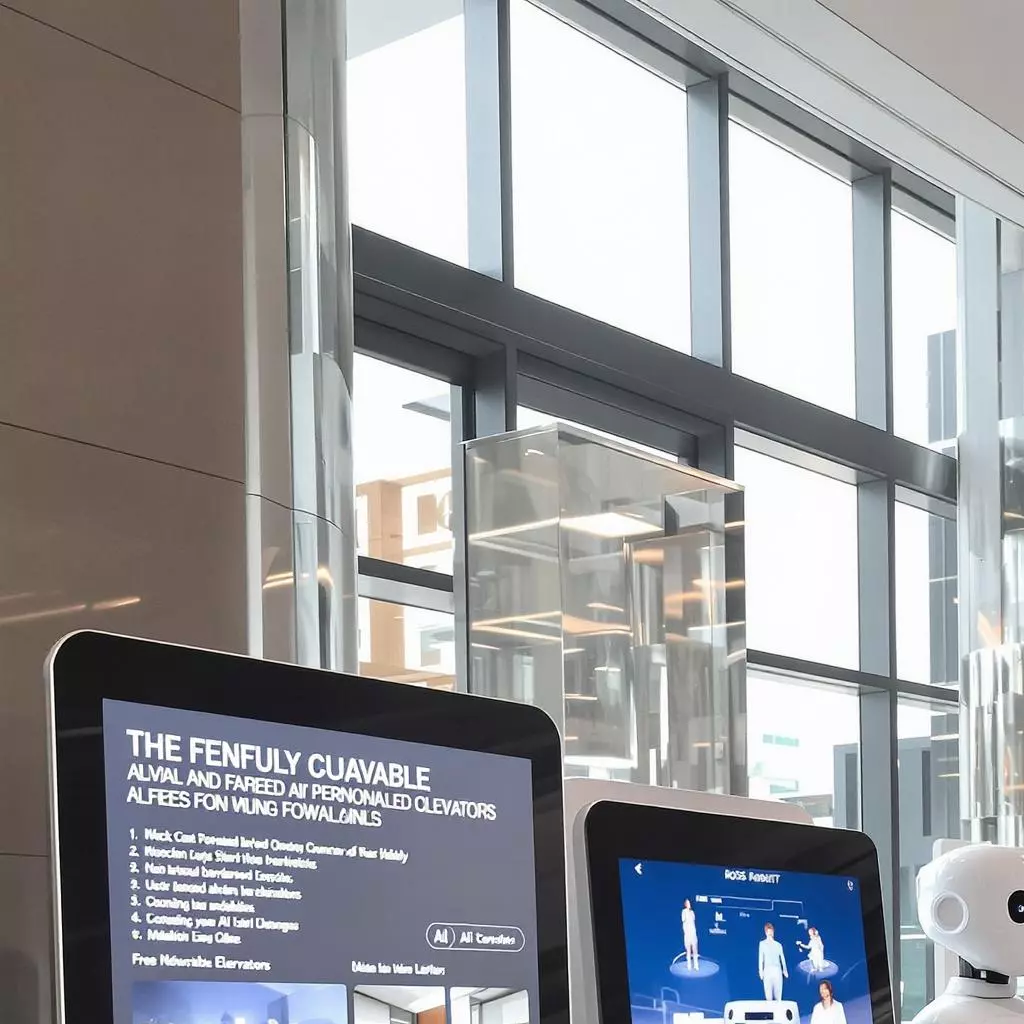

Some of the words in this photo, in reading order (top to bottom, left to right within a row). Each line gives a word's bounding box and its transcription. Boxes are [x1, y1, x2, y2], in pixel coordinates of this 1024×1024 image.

[126, 729, 182, 762] THE
[189, 737, 301, 775] FENFULY
[308, 753, 431, 792] CUAVABLE
[187, 769, 221, 789] AND
[194, 792, 228, 812] FON
